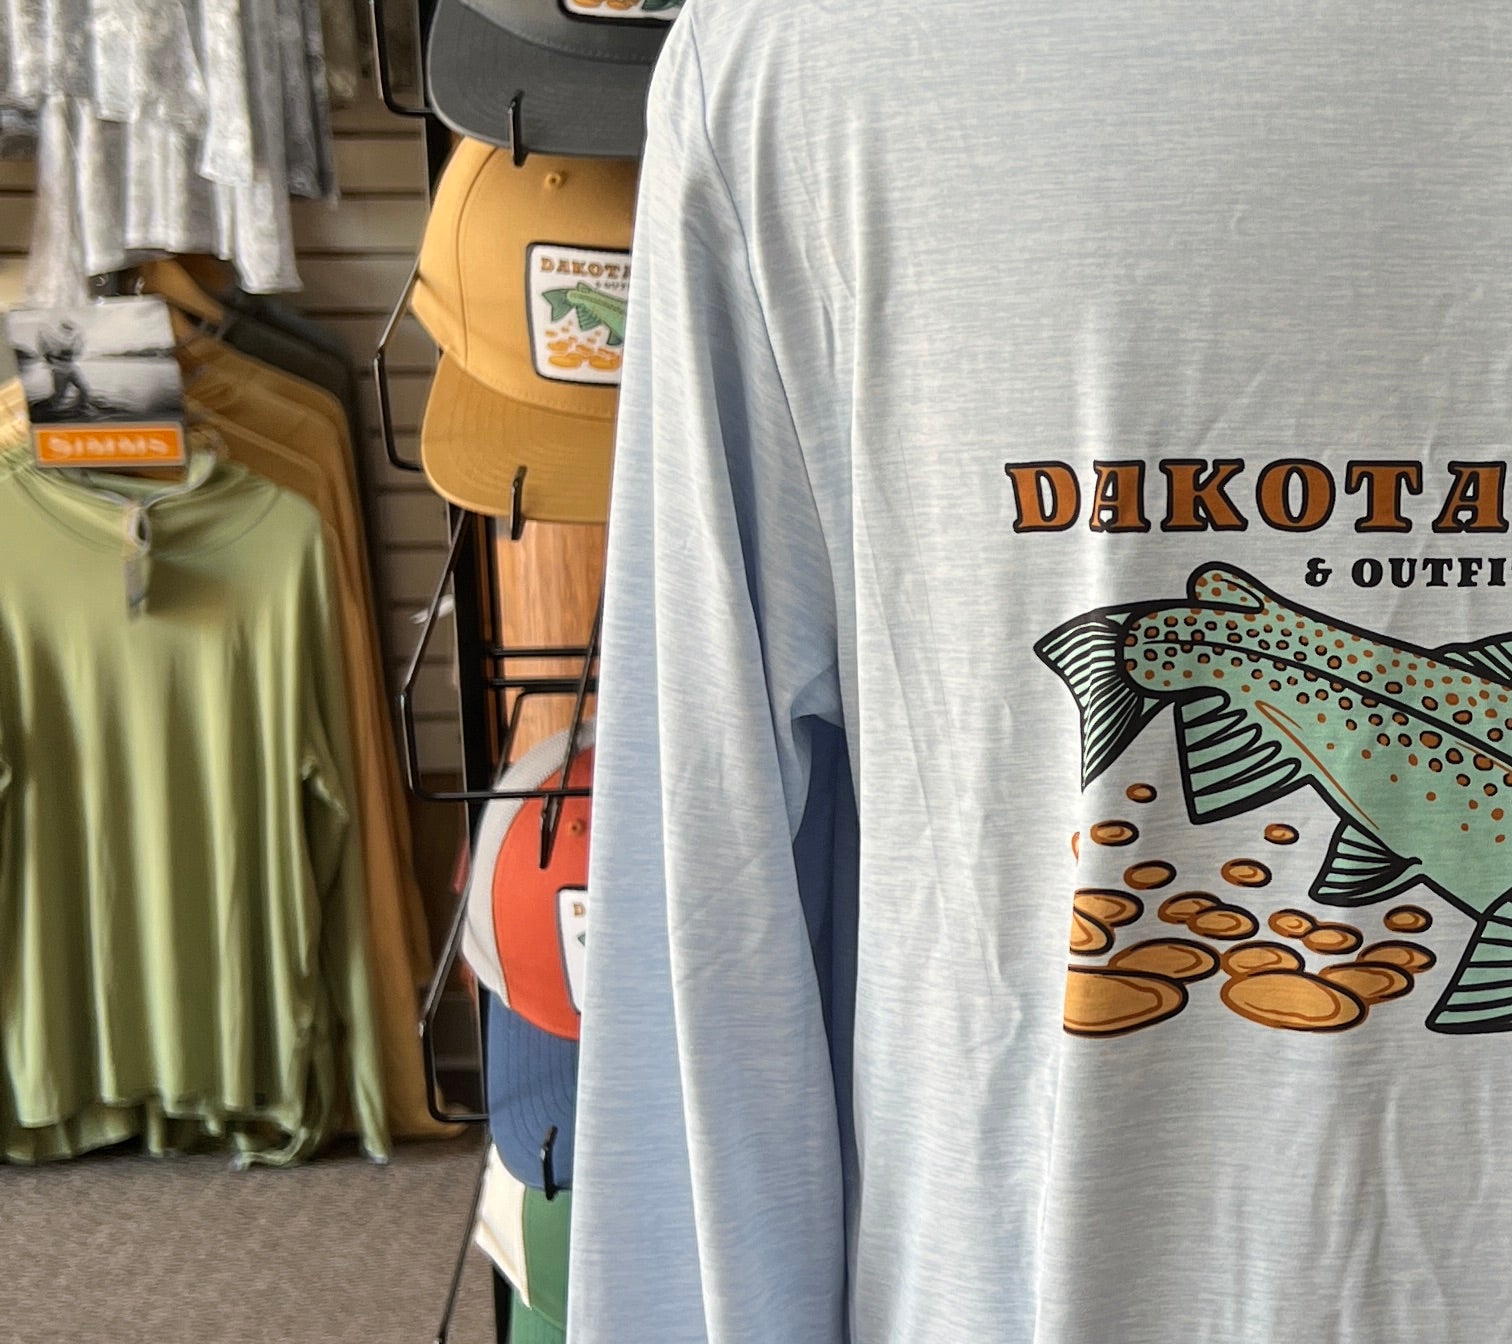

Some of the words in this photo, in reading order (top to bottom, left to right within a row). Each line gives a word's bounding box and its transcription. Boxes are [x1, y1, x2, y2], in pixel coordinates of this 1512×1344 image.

[49, 435, 170, 459] SIMMS
[1004, 458, 1510, 535] DAKOTA
[1304, 557, 1333, 589] &
